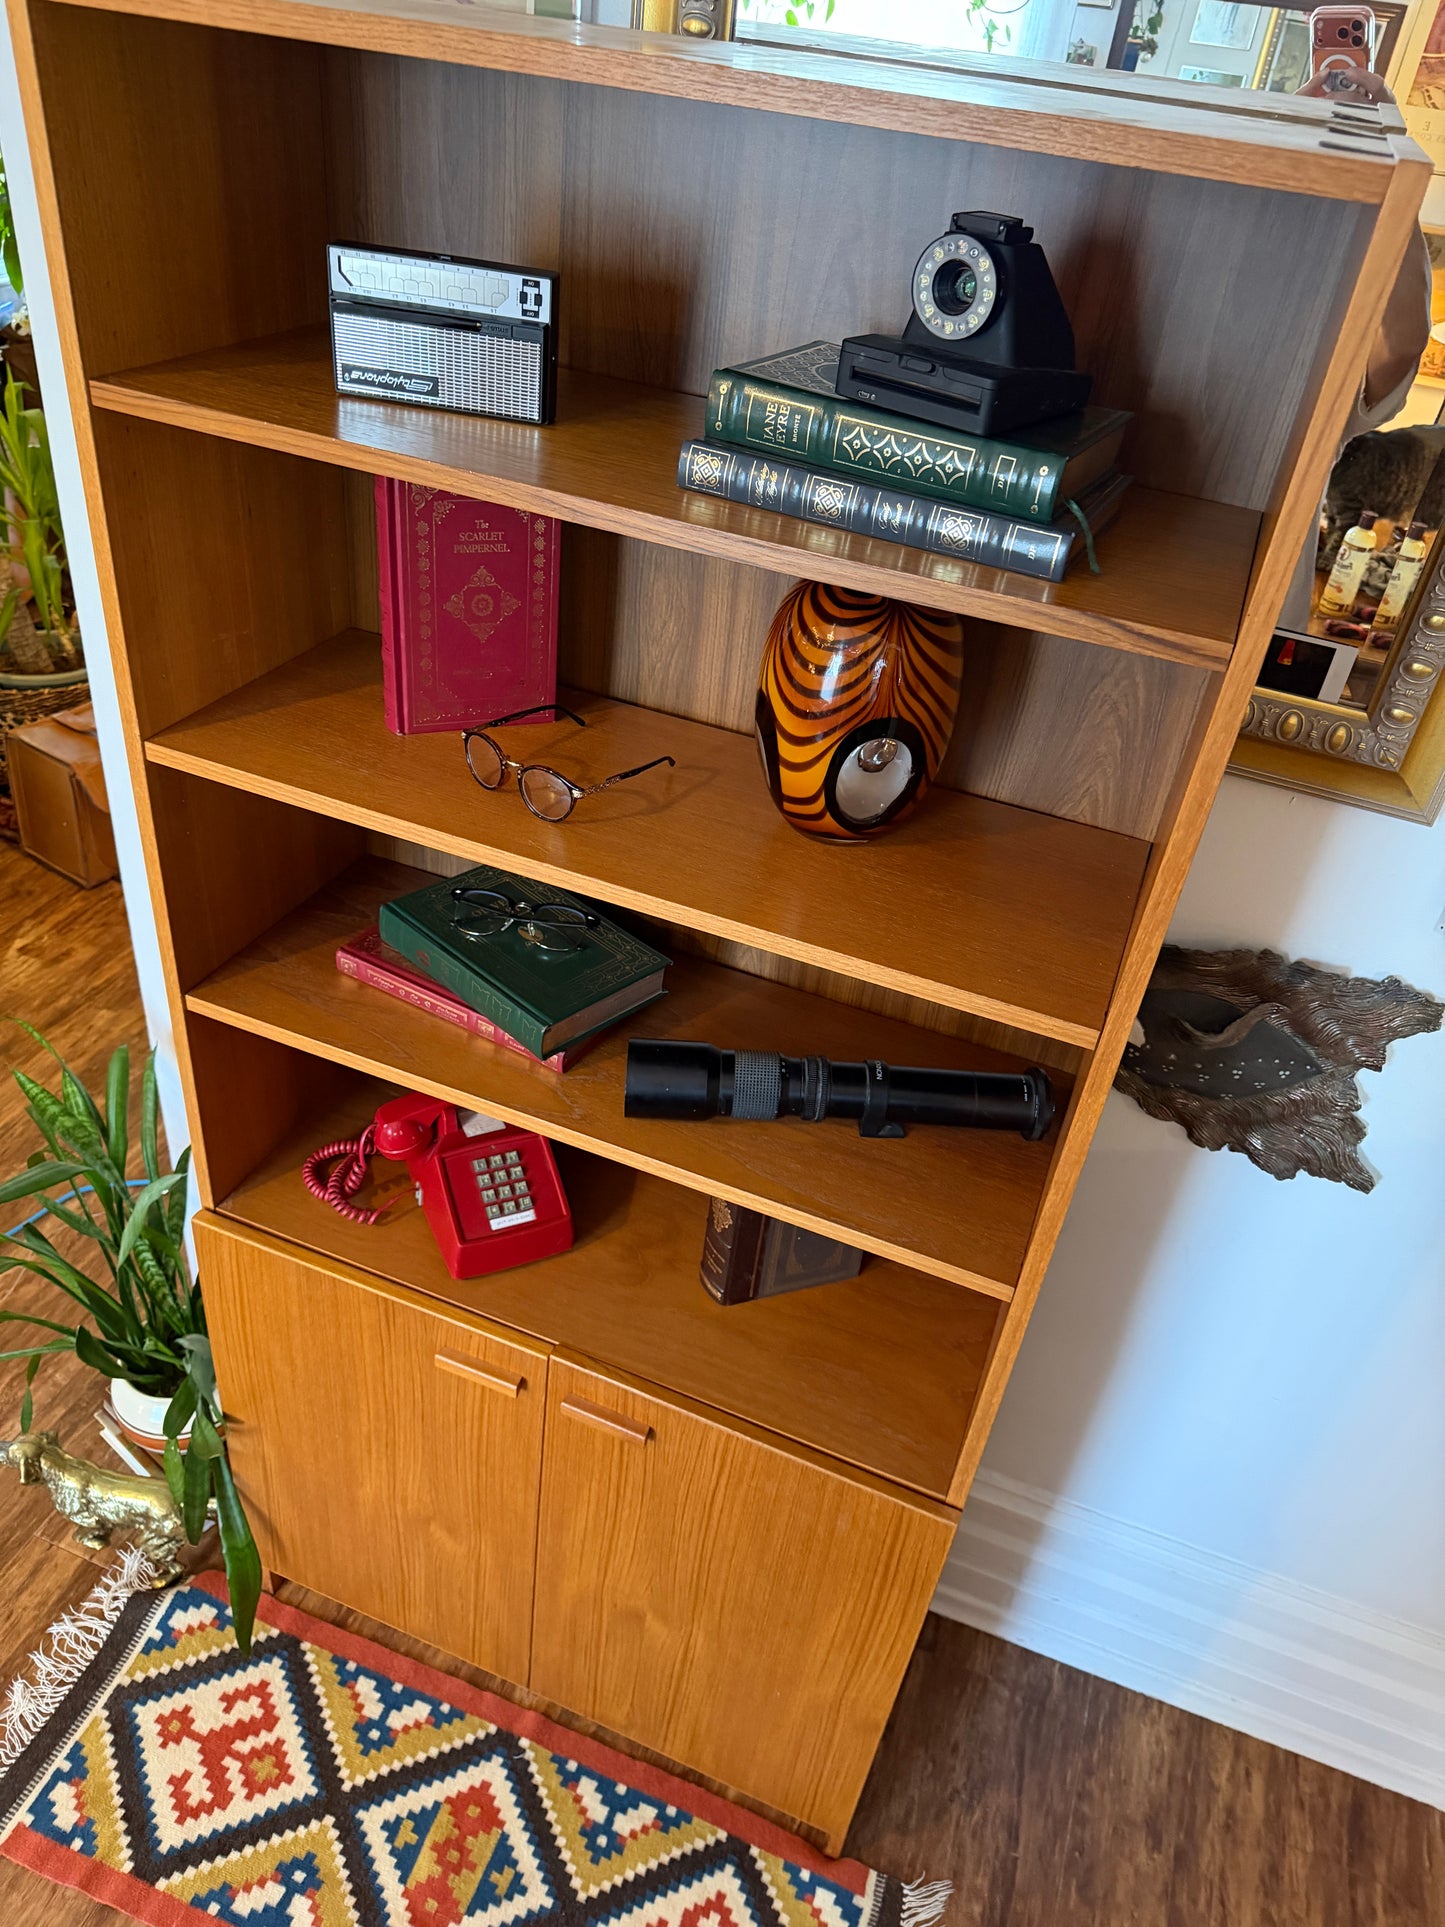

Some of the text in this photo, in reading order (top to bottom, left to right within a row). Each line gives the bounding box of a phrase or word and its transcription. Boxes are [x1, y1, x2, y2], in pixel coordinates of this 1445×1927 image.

[350, 370, 433, 393] Stylophone
[763, 402, 777, 442] JANE
[776, 404, 790, 444] EYRE
[475, 520, 489, 529] The
[459, 532, 504, 541] SCARLET
[453, 543, 509, 554] PIMPERNEL
